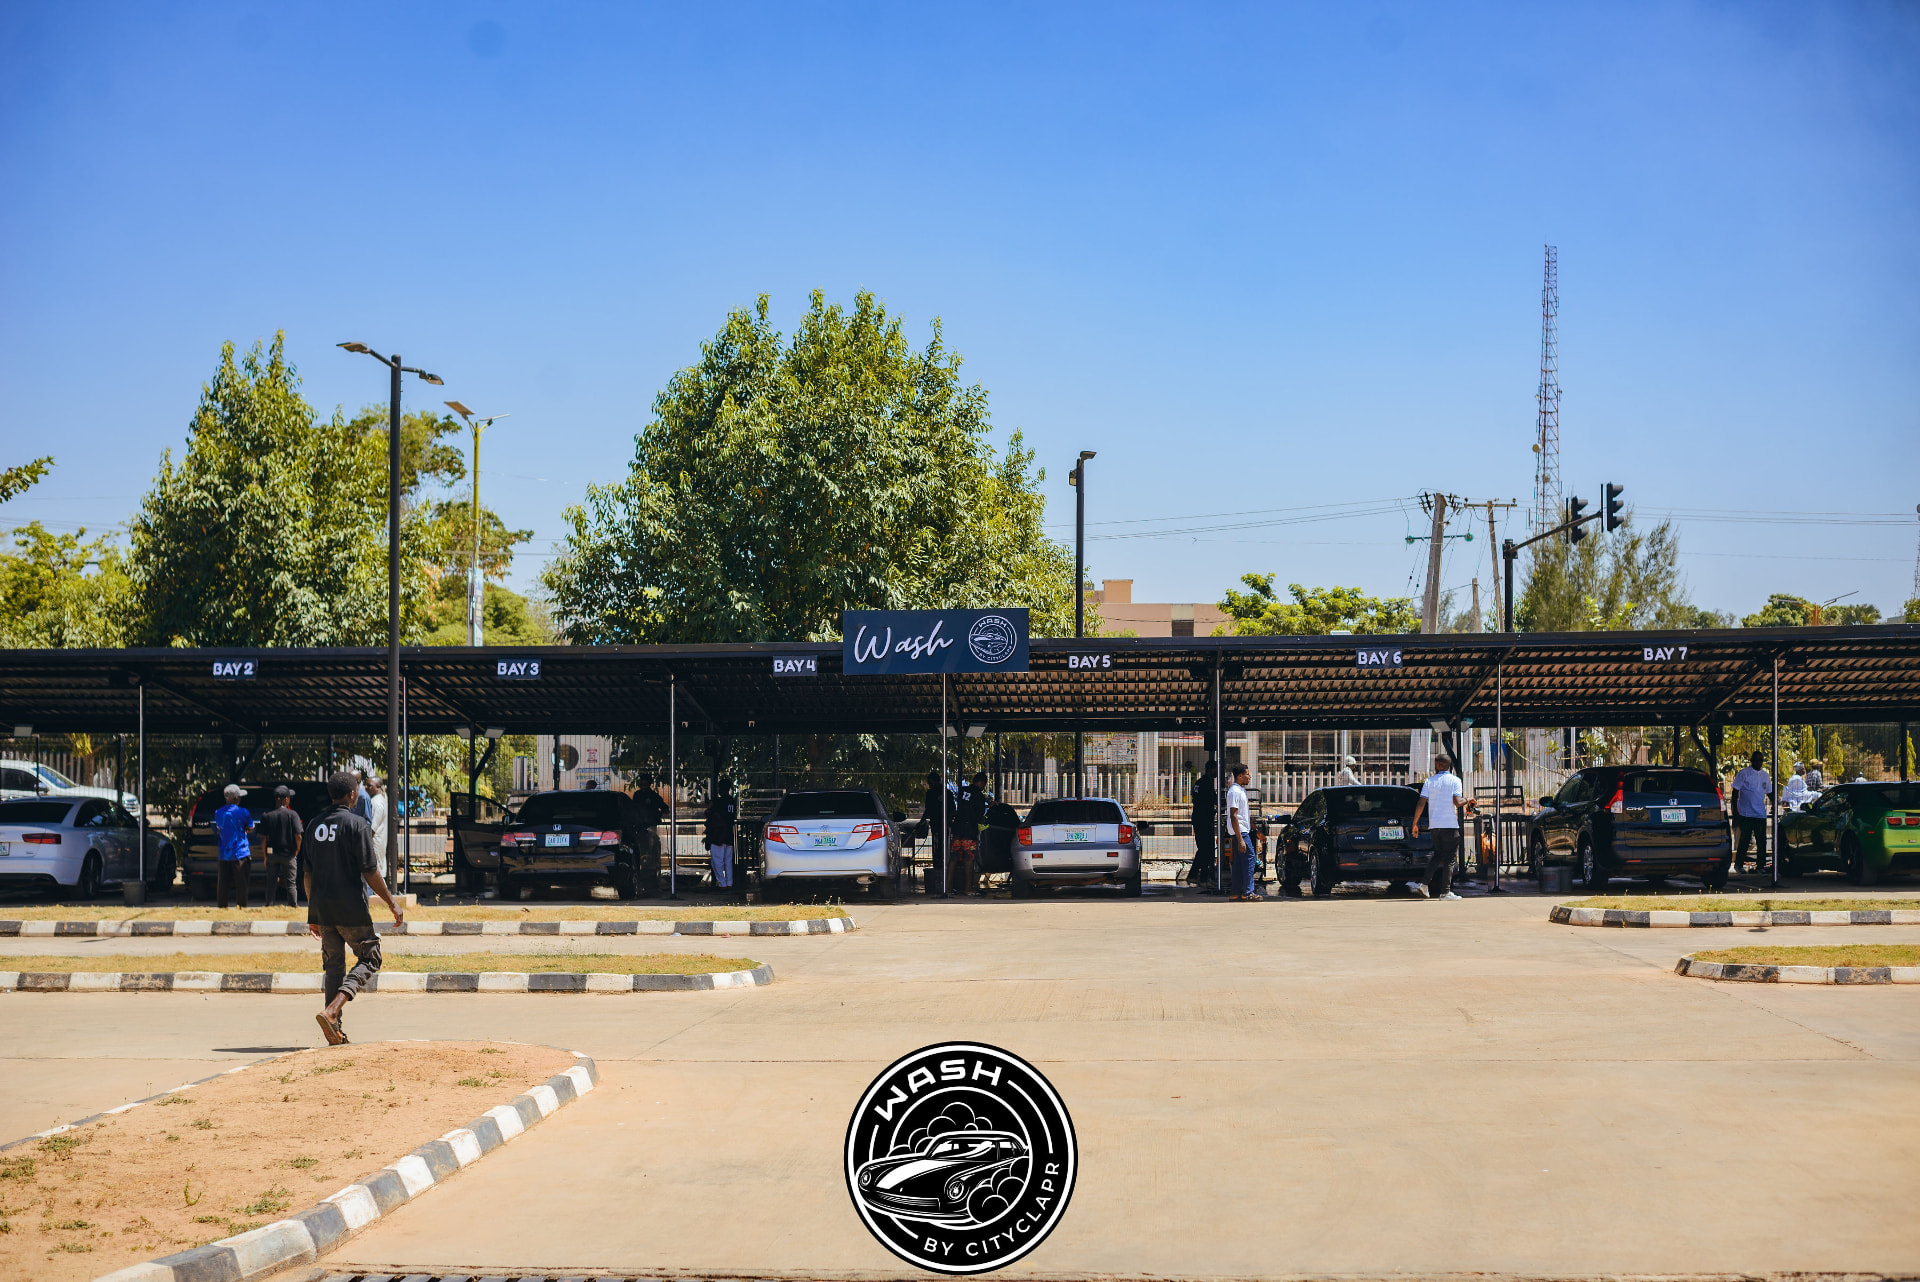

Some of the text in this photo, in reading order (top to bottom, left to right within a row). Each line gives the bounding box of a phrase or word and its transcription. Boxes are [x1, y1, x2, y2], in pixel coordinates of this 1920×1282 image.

[978, 618, 1008, 628] WASH
[854, 619, 954, 663] Wash
[1357, 650, 1402, 665] BAY 6
[1643, 646, 1688, 661] BAY 7
[212, 662, 254, 676] BAY 2
[497, 662, 539, 676] BAY 3
[773, 659, 816, 673] BAY 4
[1068, 654, 1111, 669] BAY 5
[314, 823, 338, 842] 05
